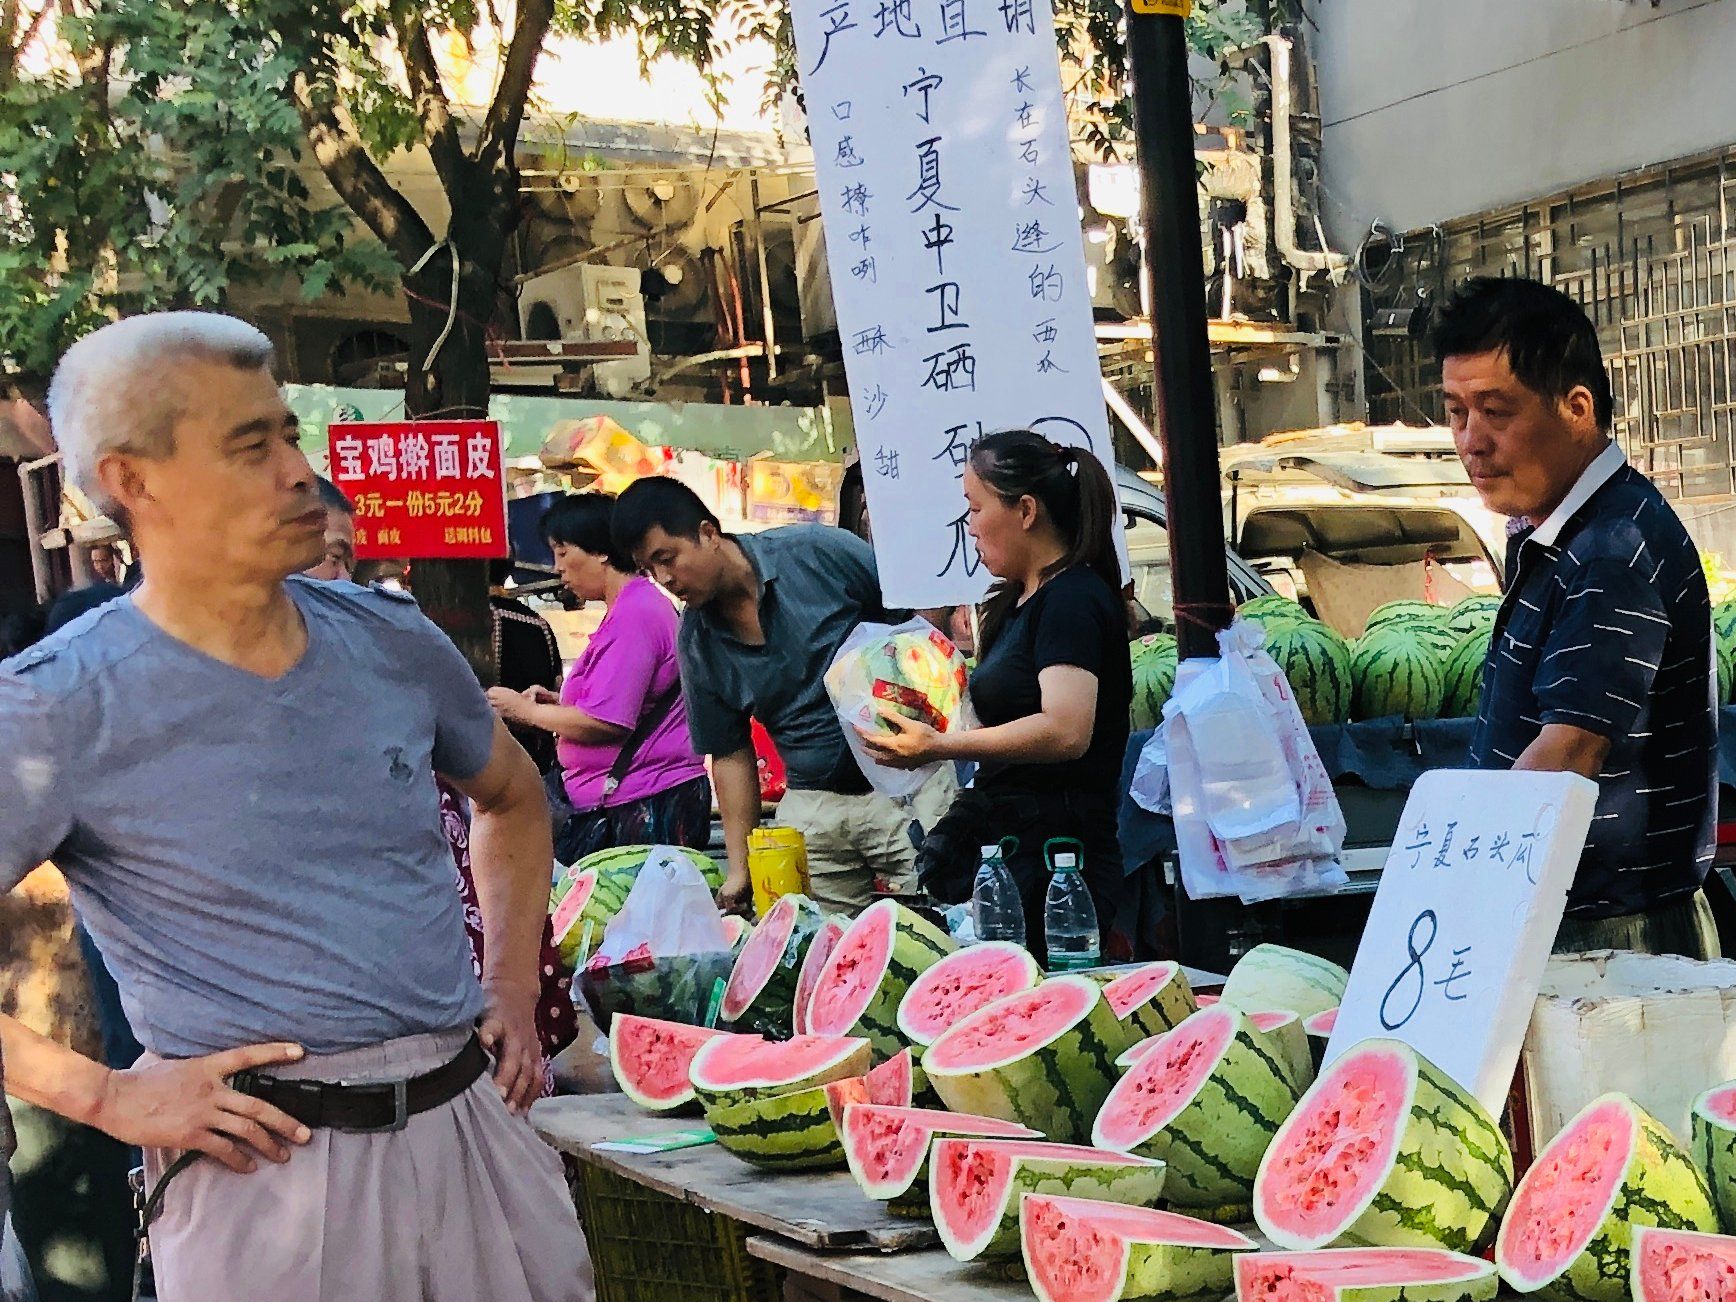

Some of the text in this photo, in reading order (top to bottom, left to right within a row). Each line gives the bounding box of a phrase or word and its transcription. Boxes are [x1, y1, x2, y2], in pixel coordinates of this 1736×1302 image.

[335, 431, 496, 482] 宝鸡擀面皮
